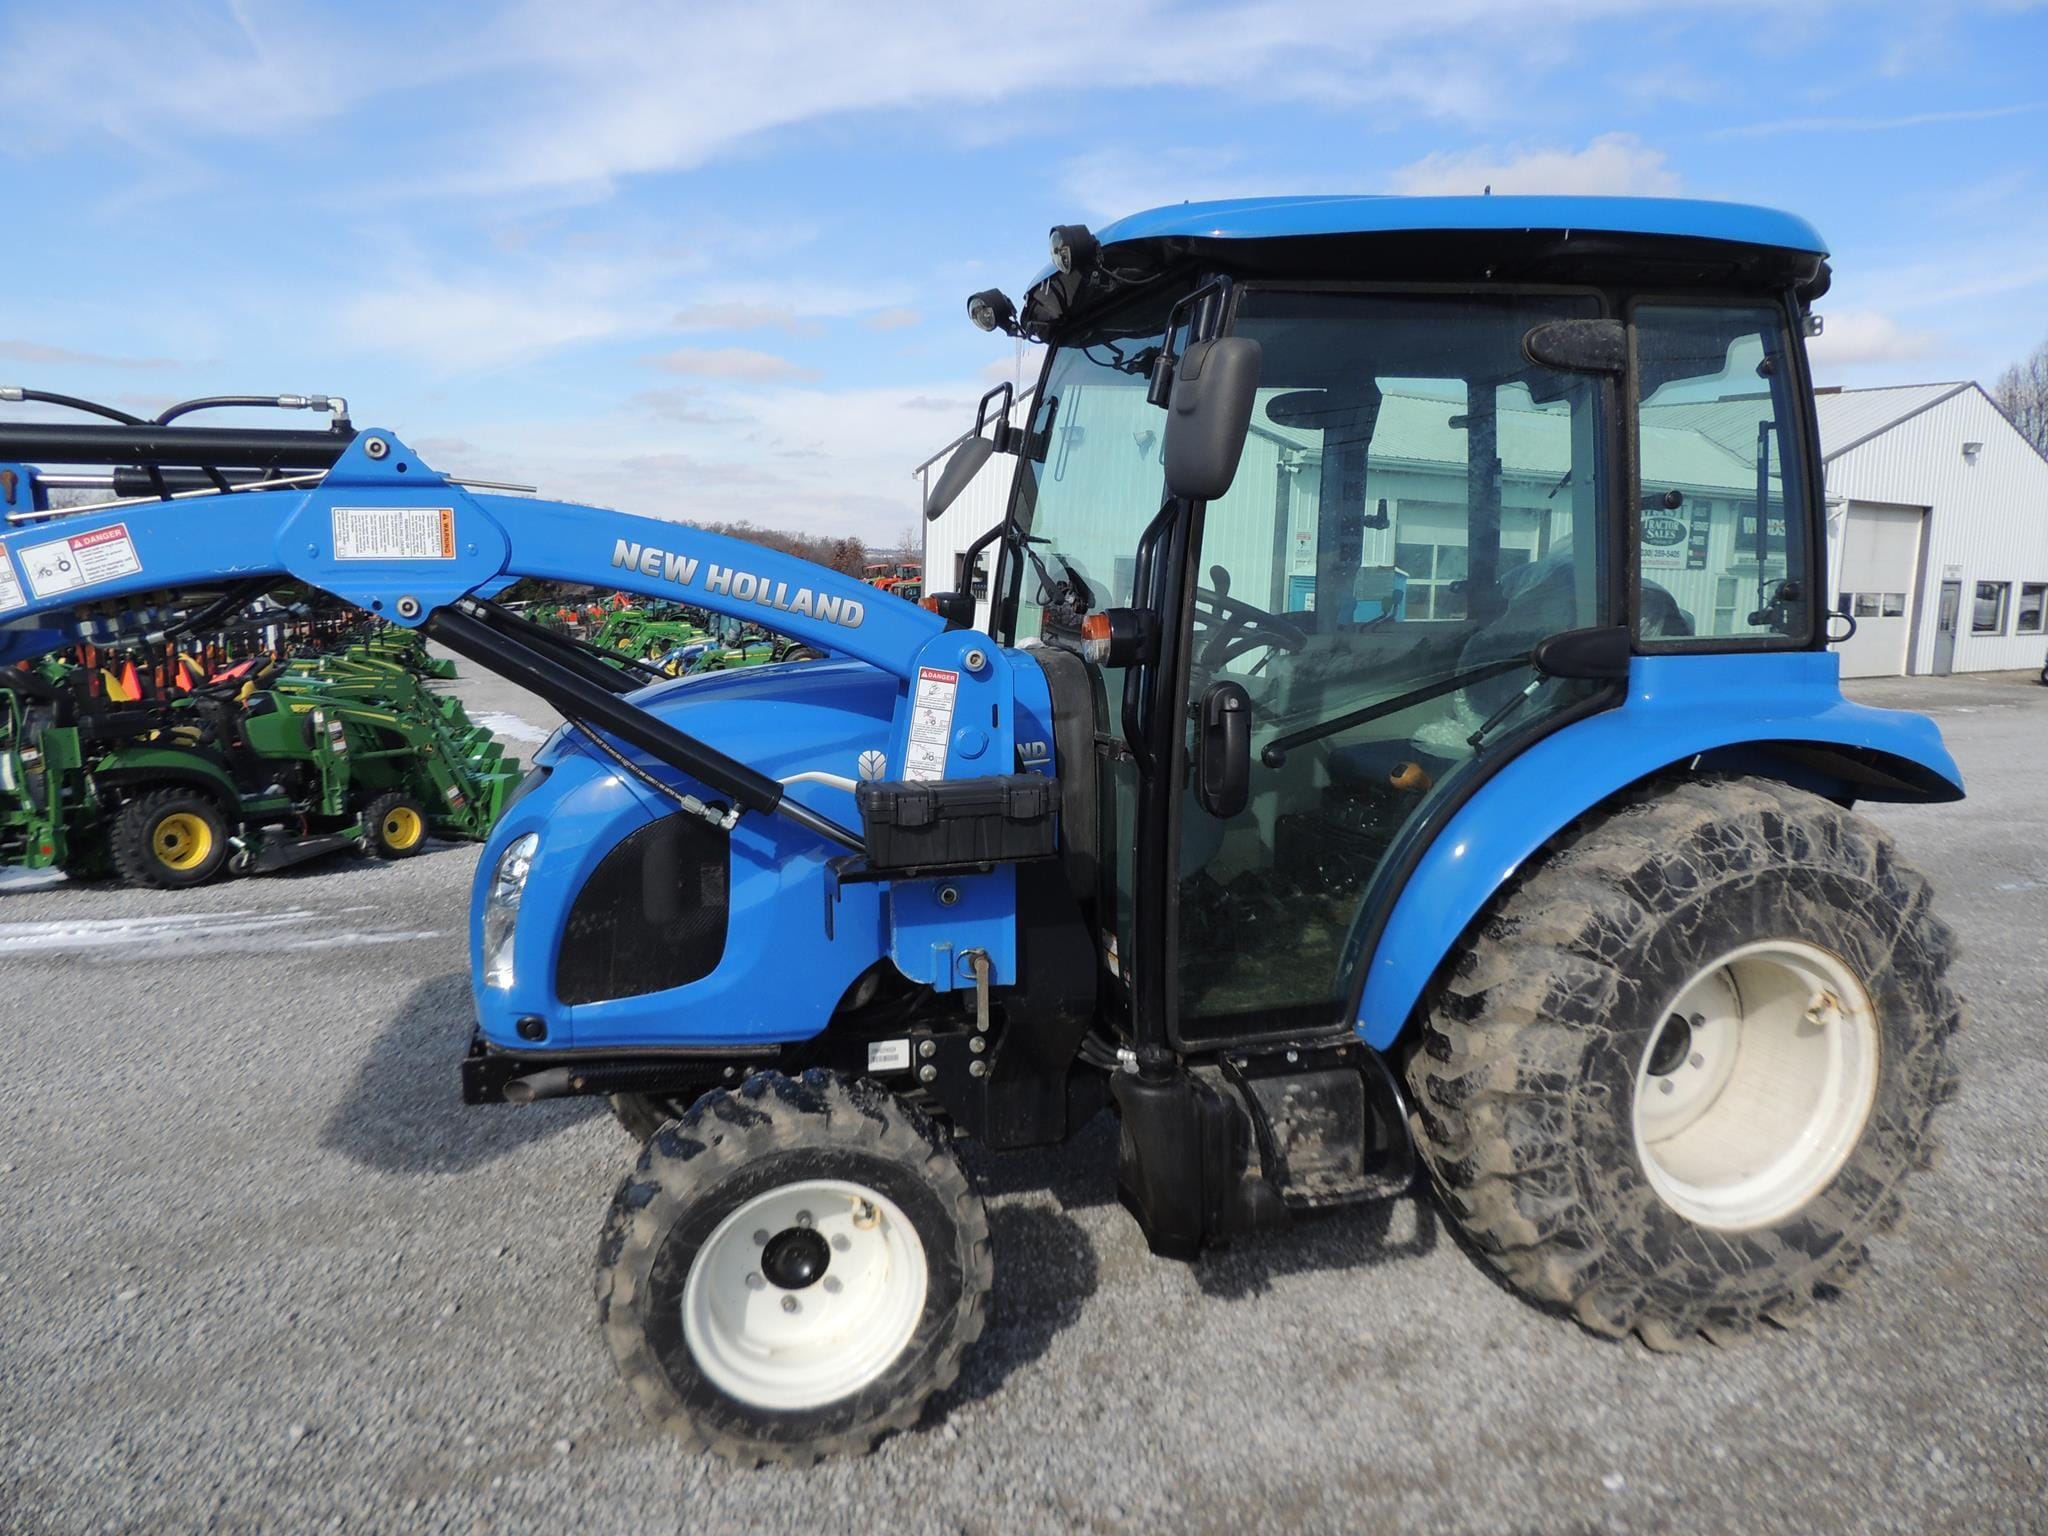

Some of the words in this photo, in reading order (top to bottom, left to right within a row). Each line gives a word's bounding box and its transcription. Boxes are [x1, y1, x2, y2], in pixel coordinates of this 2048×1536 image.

[1643, 519, 1680, 530] TRACTOR
[83, 529, 122, 545] DANGER
[443, 522, 451, 554] WARNING
[1646, 528, 1676, 539] SALES
[611, 538, 699, 586] NEW
[704, 563, 865, 629] HOLLAND
[927, 672, 955, 682] DANGER
